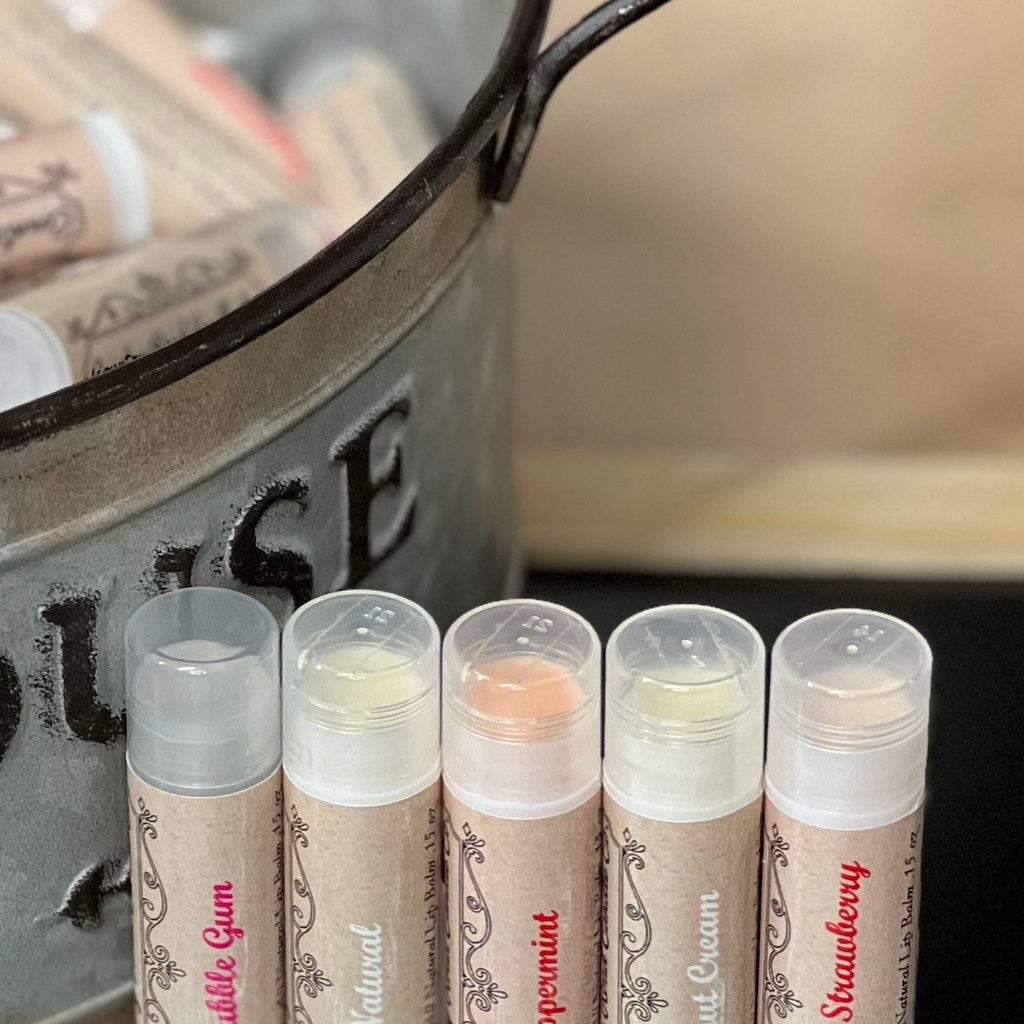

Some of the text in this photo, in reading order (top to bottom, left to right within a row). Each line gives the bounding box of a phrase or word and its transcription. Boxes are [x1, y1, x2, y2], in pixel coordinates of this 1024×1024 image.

[907, 825, 921, 849] oz
[423, 859, 436, 901] Balm
[202, 881, 245, 950] Gum
[424, 904, 439, 934] Lip
[900, 885, 915, 928] Balm
[687, 888, 721, 984] Cream
[819, 860, 872, 1023] Strawberry
[898, 930, 914, 963] Lip
[424, 937, 436, 1001] Natural
